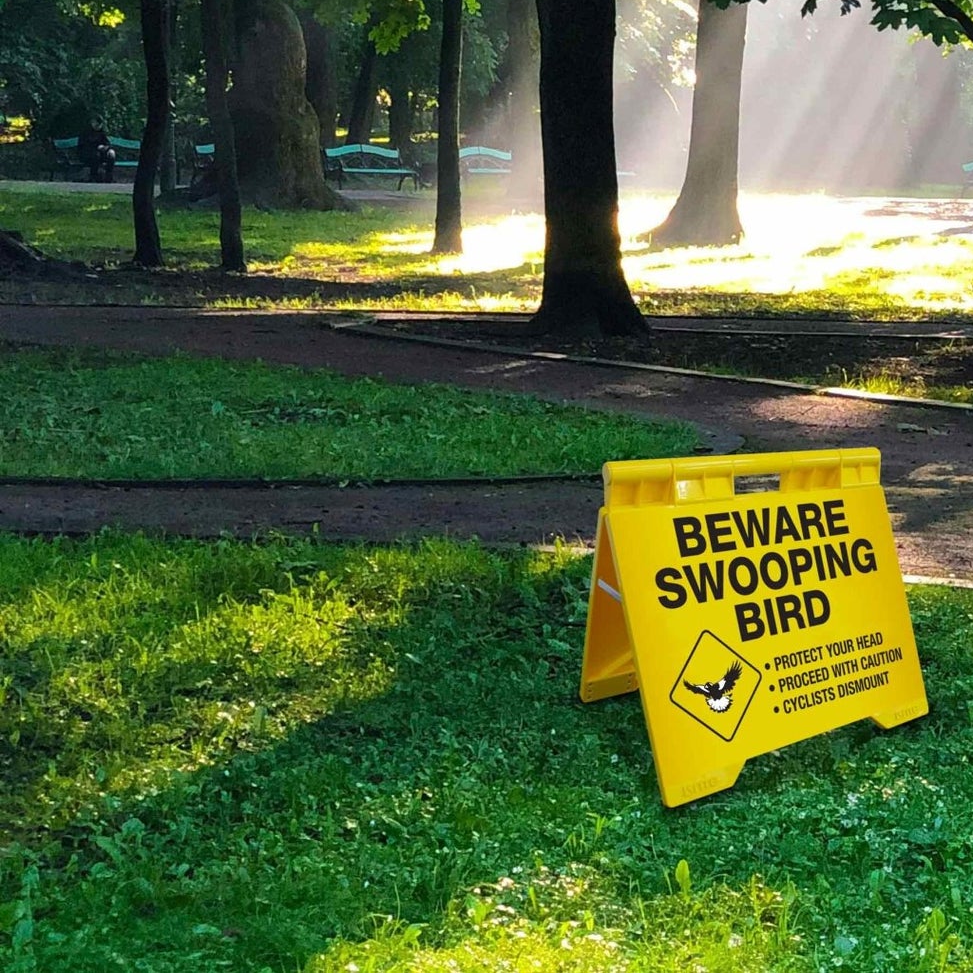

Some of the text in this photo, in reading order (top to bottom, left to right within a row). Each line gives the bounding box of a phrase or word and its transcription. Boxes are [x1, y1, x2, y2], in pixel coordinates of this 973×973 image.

[673, 499, 849, 558] BEWARE
[655, 538, 877, 610] SWOOPING
[734, 589, 830, 643] BIRD
[774, 631, 883, 671] PROTECT YOUR HEAD
[778, 647, 903, 694] PROCEED WITH CAUTION
[783, 671, 890, 714] CYCLISTS DISMOUNT
